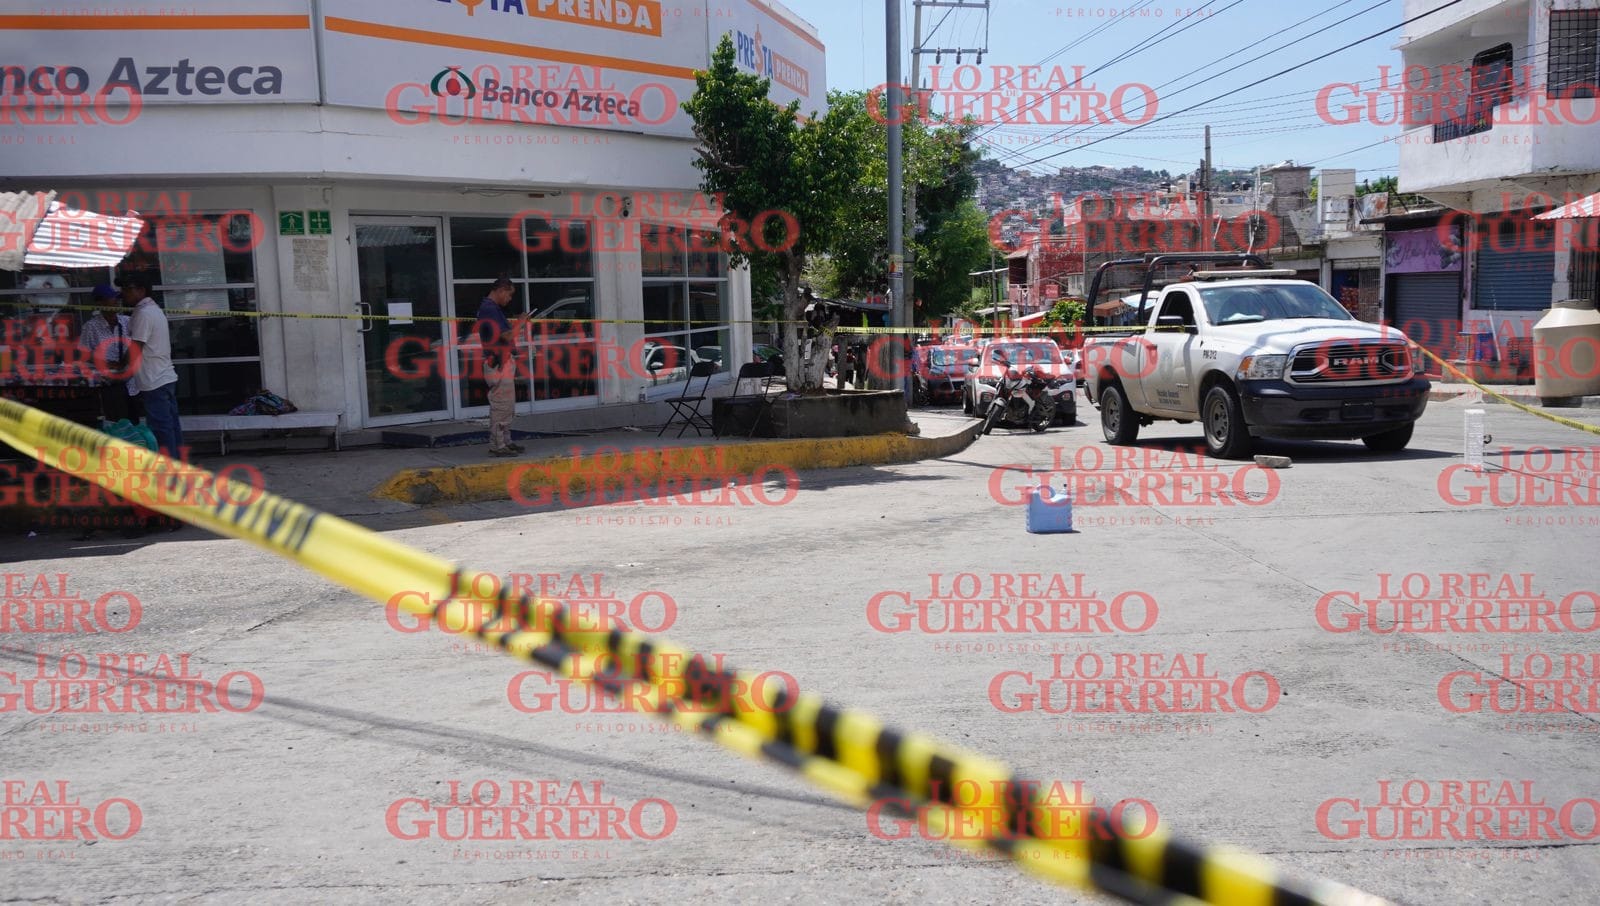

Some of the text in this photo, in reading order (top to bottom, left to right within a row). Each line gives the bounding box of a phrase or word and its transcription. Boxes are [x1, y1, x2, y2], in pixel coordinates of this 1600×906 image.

[101, 57, 283, 96] Azteca
[482, 78, 640, 117] Banco Azteca
[1333, 356, 1379, 366] RAM
